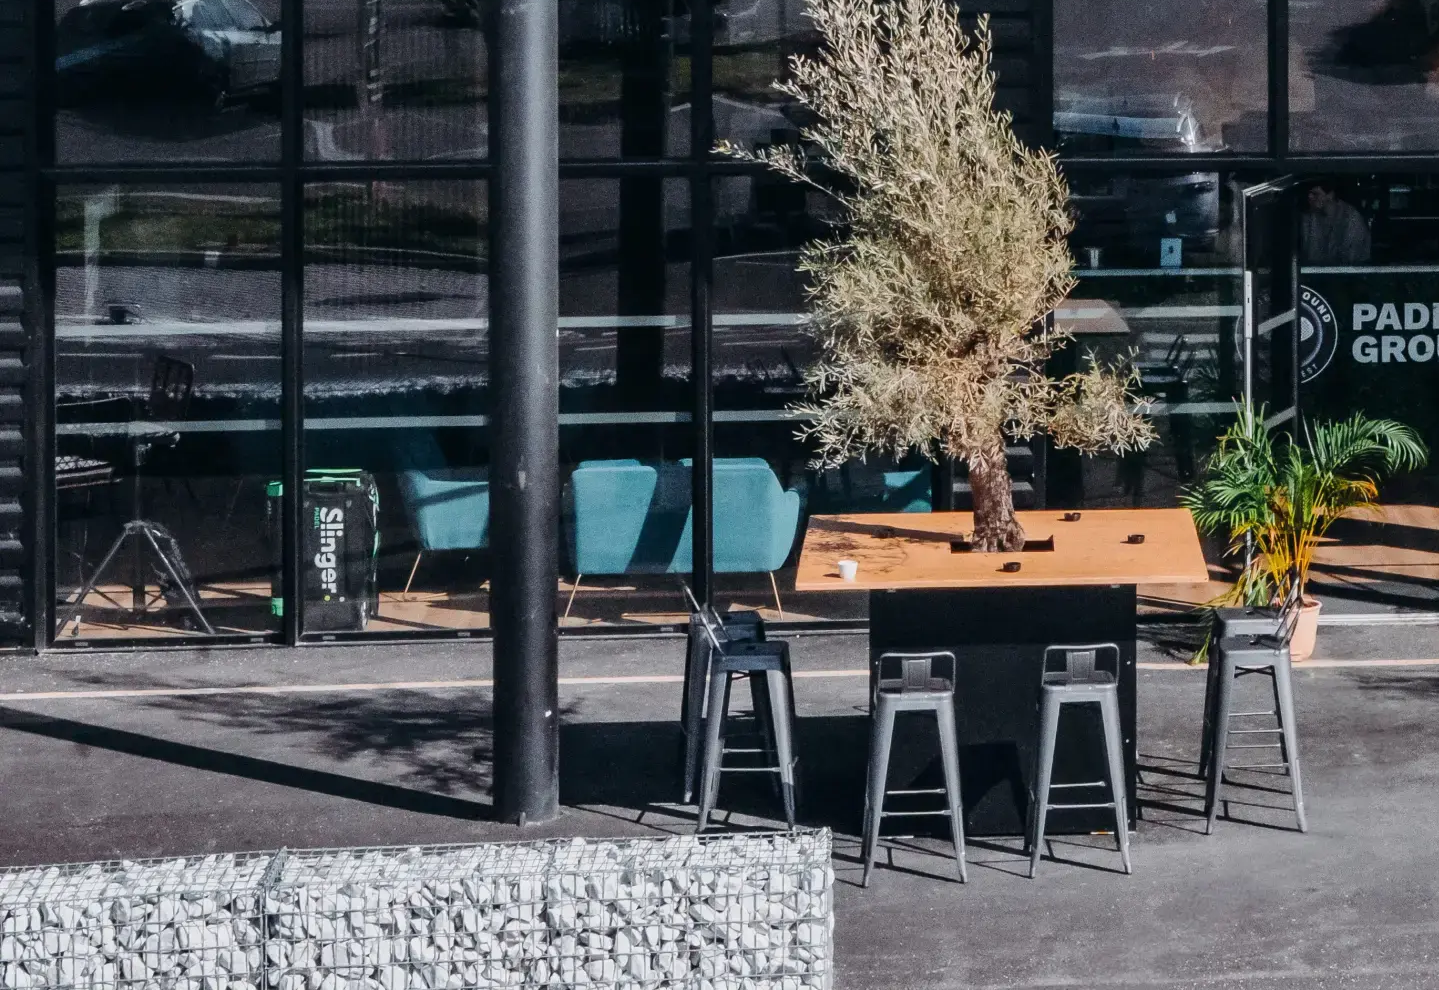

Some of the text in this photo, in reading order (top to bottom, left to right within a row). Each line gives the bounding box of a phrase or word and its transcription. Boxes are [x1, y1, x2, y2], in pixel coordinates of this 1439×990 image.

[1301, 291, 1332, 324] OUND
[1300, 363, 1318, 378] EST
[314, 506, 344, 593] Slinger
